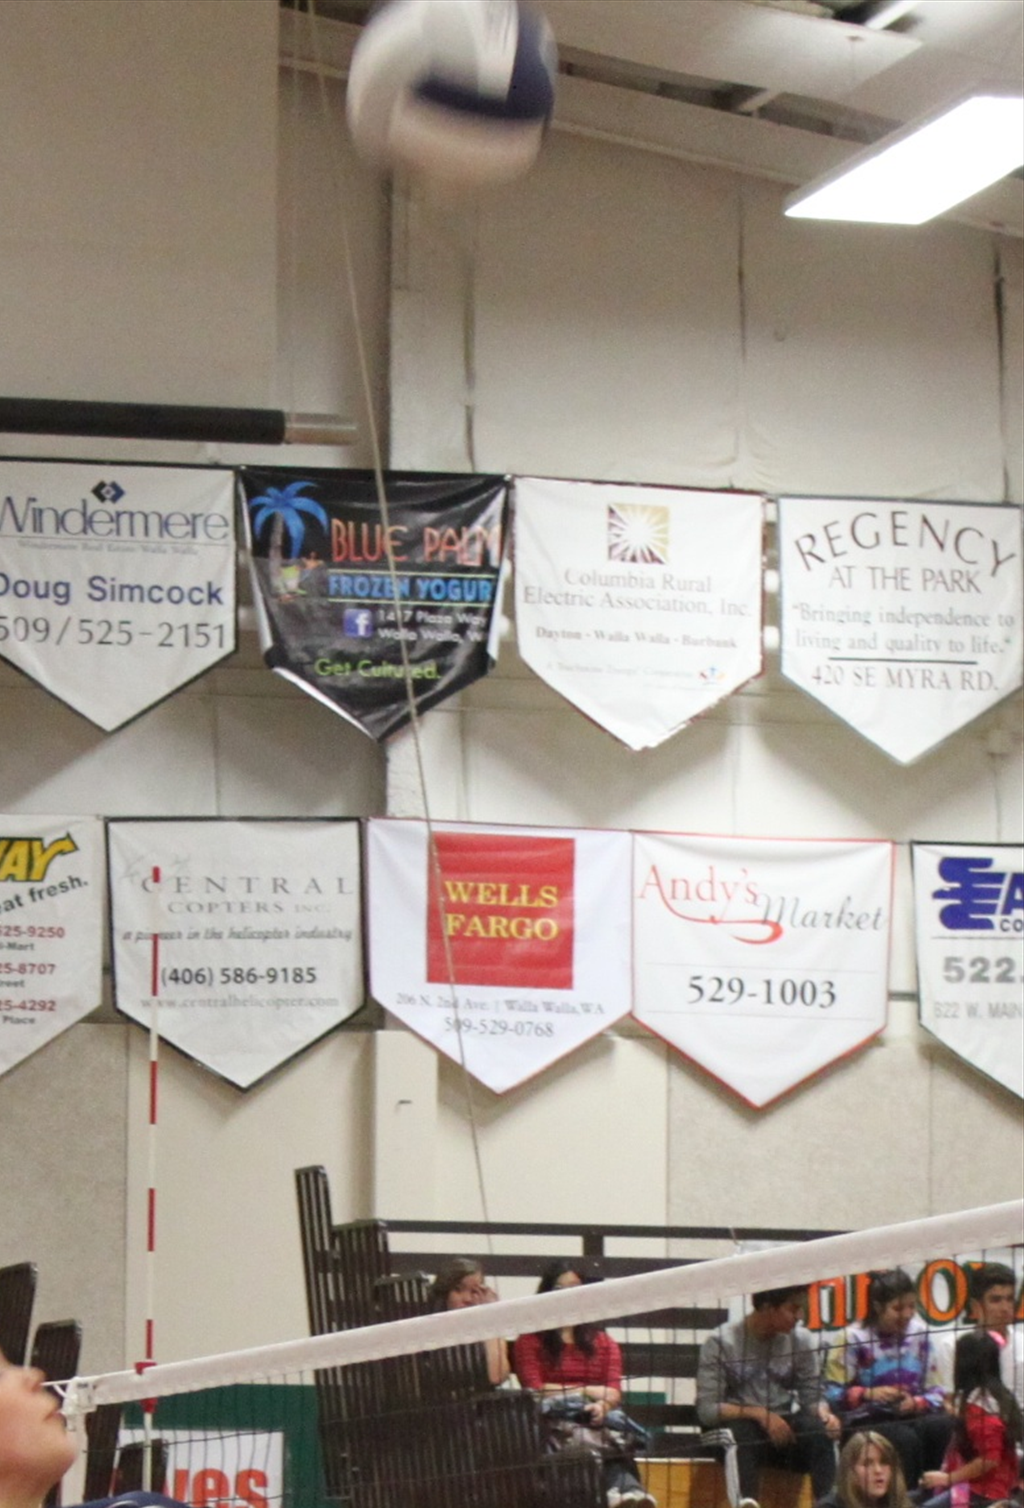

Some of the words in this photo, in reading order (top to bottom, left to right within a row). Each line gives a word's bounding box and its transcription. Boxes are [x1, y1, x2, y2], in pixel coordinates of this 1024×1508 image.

[331, 517, 409, 563] BLUE
[794, 510, 1017, 578] REGENCY
[87, 575, 224, 606] Simcock
[328, 574, 410, 599] FROZEN
[564, 567, 656, 590] Columbia
[661, 573, 712, 594] Rural
[828, 565, 856, 589] AT
[868, 566, 911, 592] THE
[922, 568, 982, 594] PARK
[523, 585, 594, 608] Electric
[600, 591, 714, 616] Association,
[719, 599, 753, 617] Inc.
[377, 609, 414, 622] 147
[878, 606, 991, 629] independence
[997, 612, 1015, 629] to
[795, 629, 842, 651] living
[847, 632, 877, 651] and
[885, 633, 946, 655] quality
[948, 637, 966, 653] to
[314, 659, 351, 678] Get
[359, 660, 441, 680] Cultued.
[811, 664, 845, 686] 420
[853, 666, 877, 688] SE
[885, 668, 953, 690] MYRA
[960, 670, 1000, 692] RD.
[28, 874, 88, 904] fresh.
[444, 880, 558, 908] WELLS
[638, 864, 761, 925] Andy's
[167, 900, 284, 915] COPTERS
[760, 893, 885, 932] Market
[445, 913, 559, 941] FARGO
[161, 967, 214, 987] (406)
[220, 967, 317, 985] 586-9185
[687, 975, 837, 1009] 529-1003
